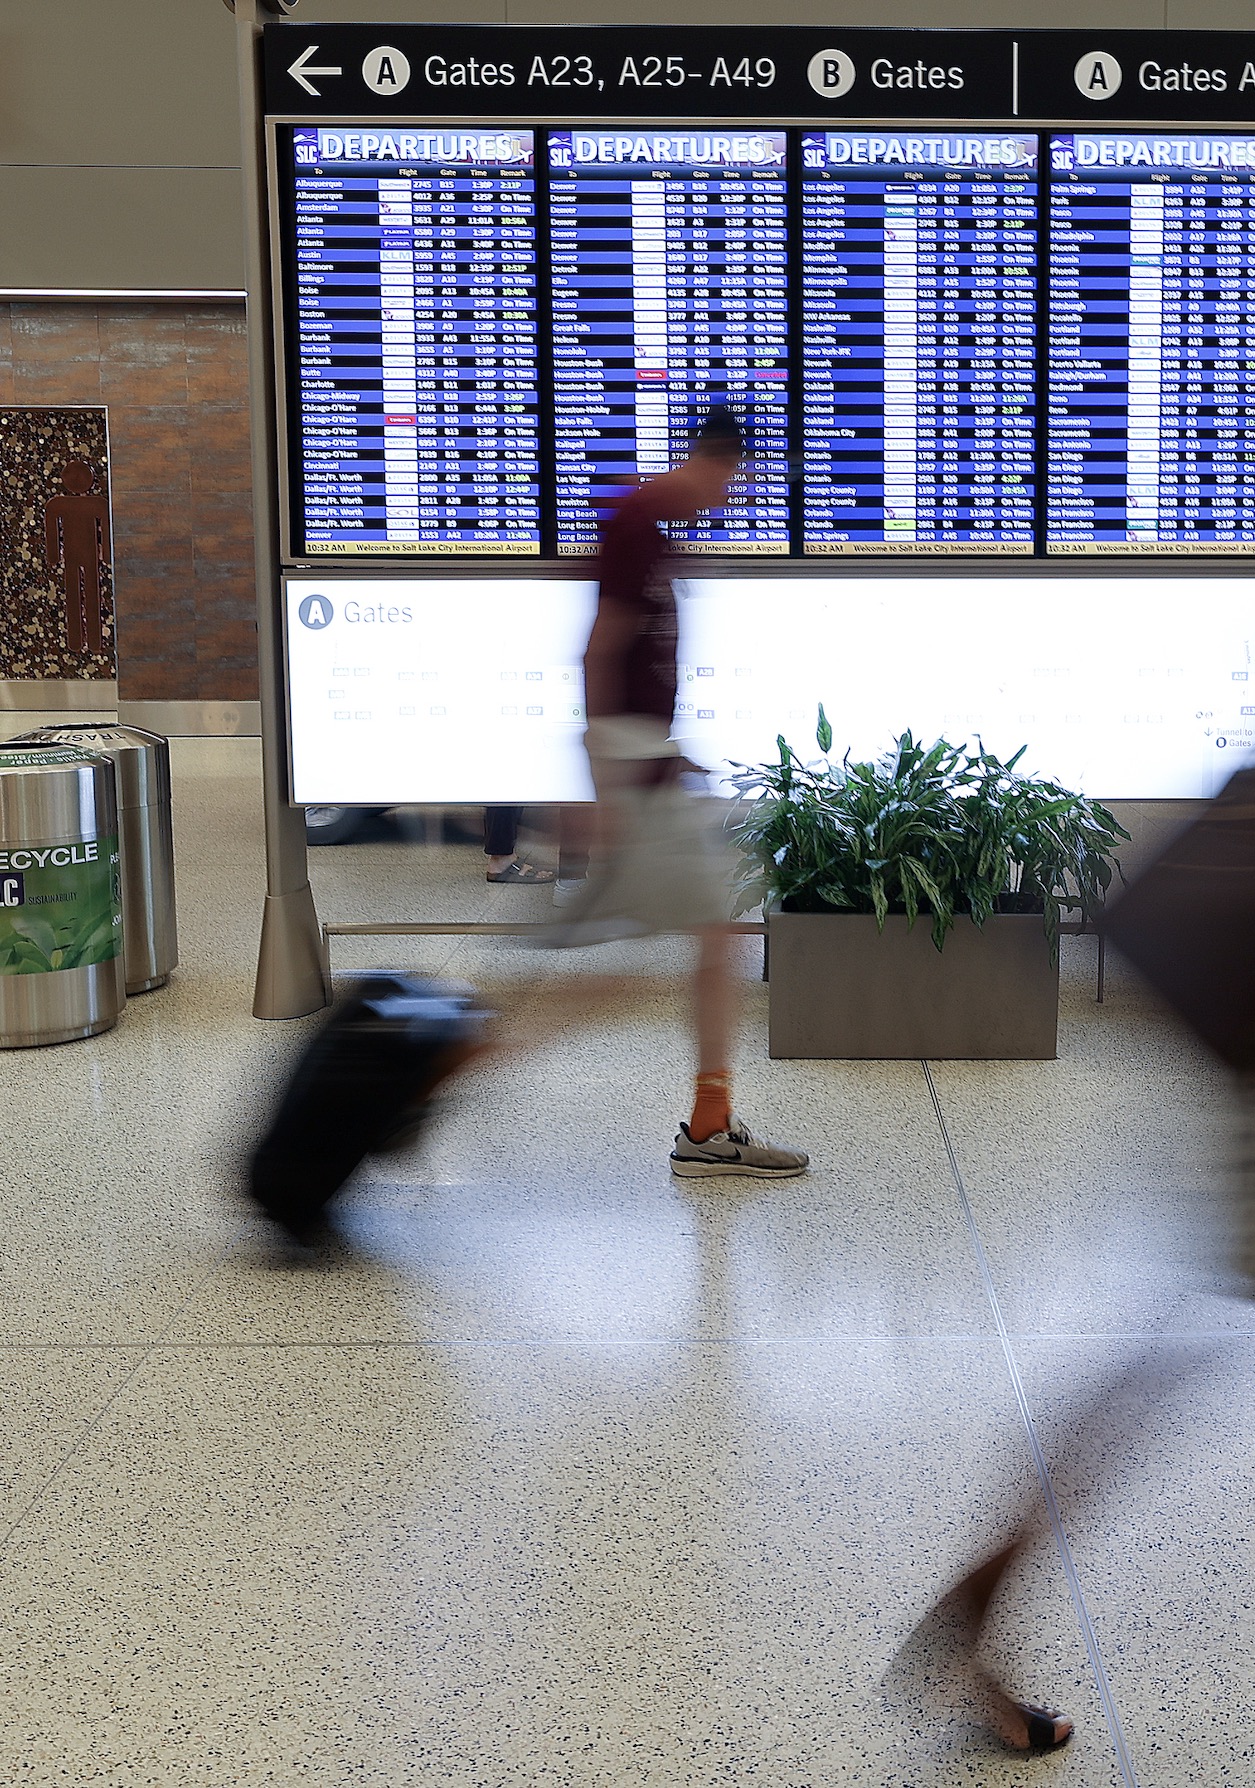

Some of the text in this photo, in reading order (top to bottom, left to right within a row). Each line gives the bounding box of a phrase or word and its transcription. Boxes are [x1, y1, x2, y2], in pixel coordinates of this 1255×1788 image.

[376, 57, 397, 86] A
[424, 56, 516, 87] Gates
[528, 56, 606, 91] A23,
[822, 59, 965, 90] B Gates
[1086, 60, 1108, 90] A
[1138, 61, 1228, 92] Gates
[323, 135, 512, 161] DEPARTURES
[576, 137, 765, 162] DEPARTURES
[830, 139, 1016, 165] DEPARTURES
[296, 145, 318, 164] SLC
[550, 148, 572, 167] SLC
[804, 149, 826, 168] SLC
[1052, 151, 1074, 170] SLC
[399, 168, 417, 176] Flight
[296, 180, 343, 189] Albuquerque
[297, 215, 323, 224] Atlanta
[298, 251, 321, 259] Austin
[298, 263, 333, 271] Baltimore
[803, 266, 847, 275] Minneapolis
[803, 348, 818, 356] New
[302, 392, 360, 401] Chicago-Midway
[302, 404, 356, 412] Chicago-O'Hare
[1048, 418, 1090, 426] Sacramento
[804, 429, 855, 438] Oklahoma City
[340, 474, 362, 482] Worth
[804, 487, 856, 496] Orange County
[1048, 498, 1061, 506] San
[557, 510, 574, 519] Long
[307, 544, 330, 552] 10:32
[357, 544, 390, 552] Welcome
[402, 544, 417, 552] Salt
[419, 544, 437, 552] Lake
[439, 544, 454, 554] City
[456, 544, 503, 552] International
[506, 545, 532, 554] Airport
[560, 544, 783, 554] 10:32 AM City International Airport
[345, 602, 413, 623] Gates
[1229, 739, 1251, 747] Gates
[29, 892, 77, 905] SUSTAINABILITY
